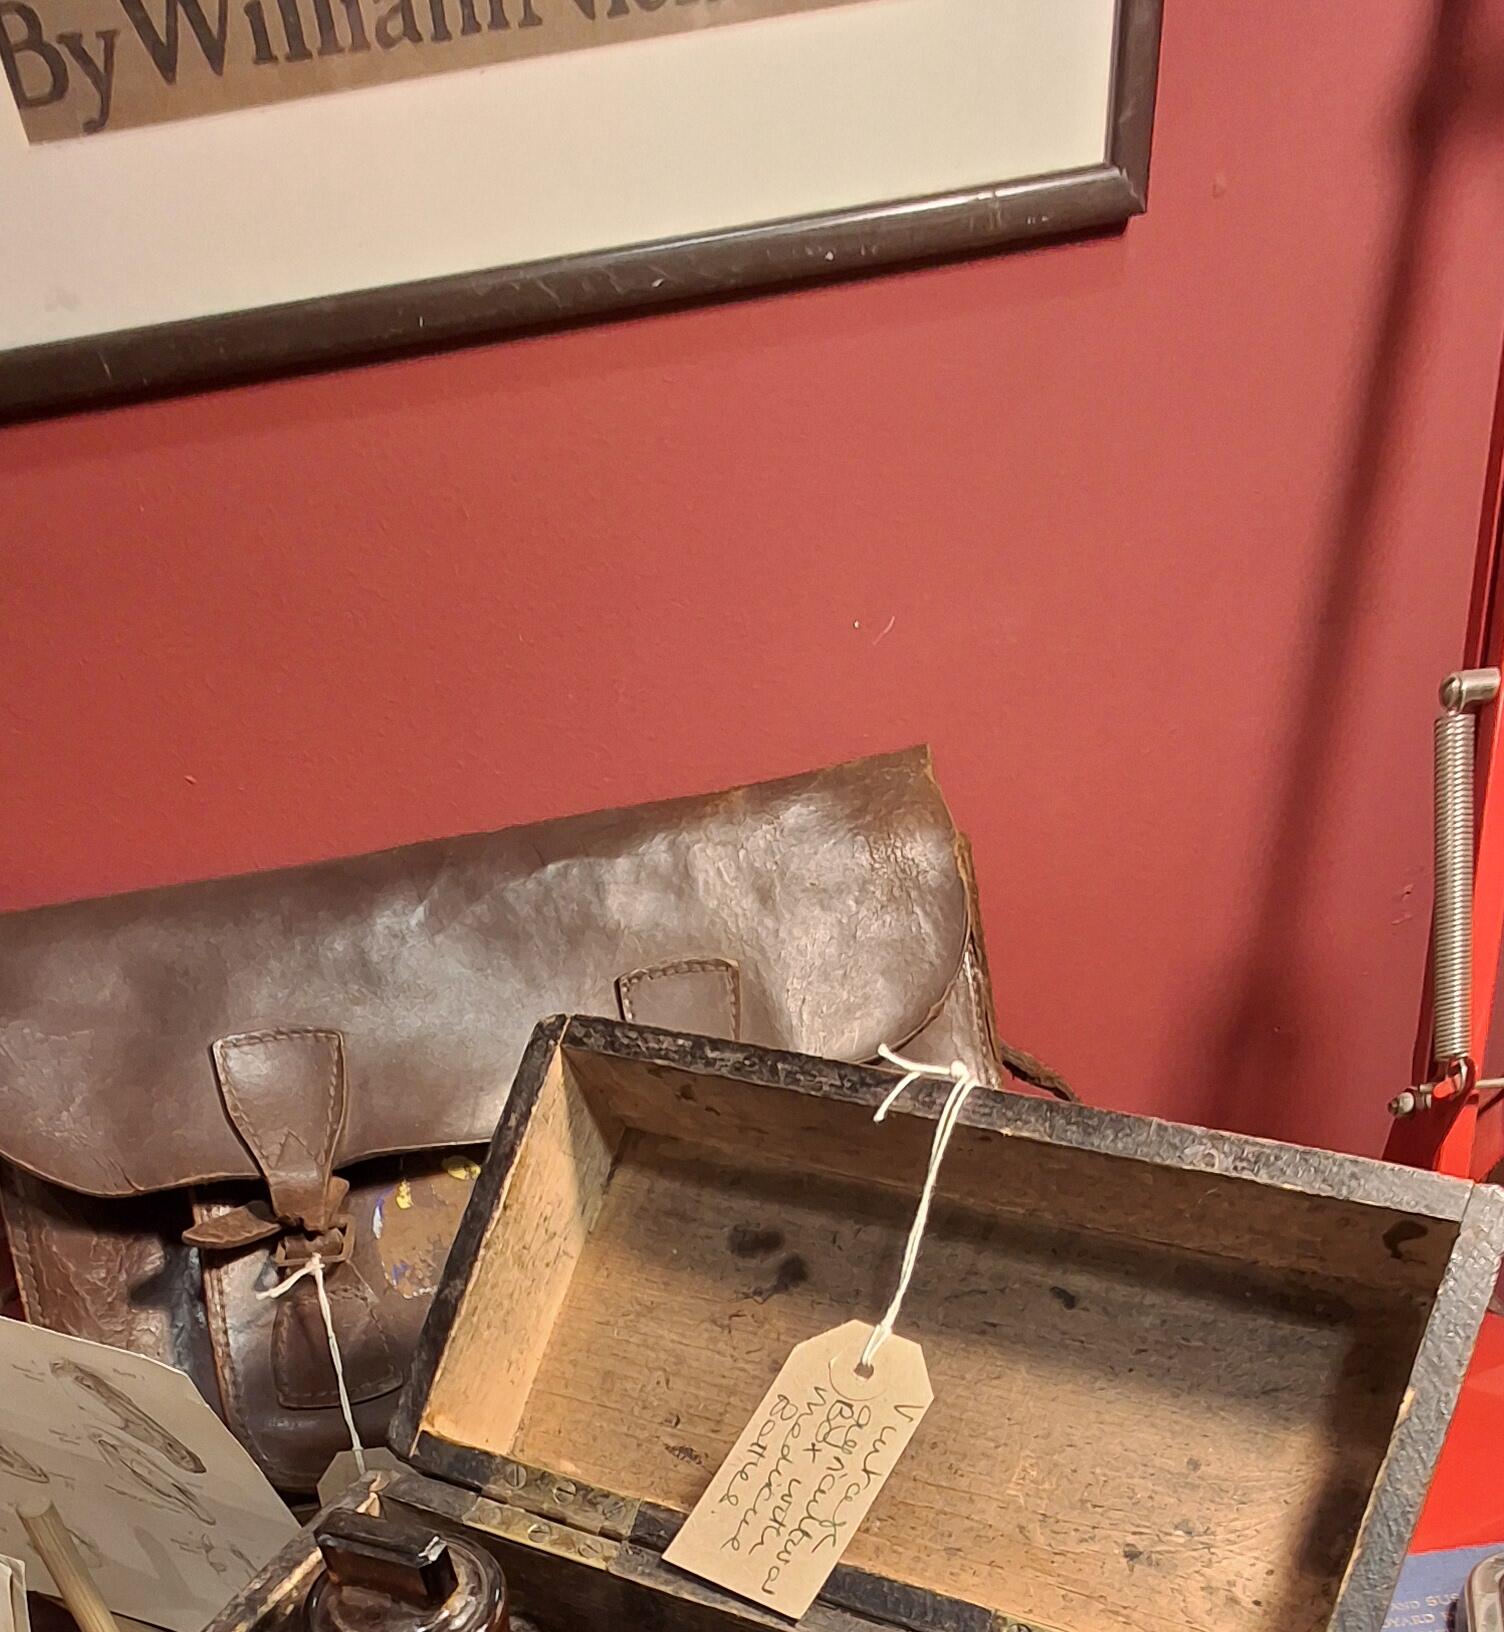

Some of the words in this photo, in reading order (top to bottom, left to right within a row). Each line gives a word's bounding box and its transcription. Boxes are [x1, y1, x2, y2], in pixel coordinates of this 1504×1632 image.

[0, 0, 119, 133] By
[802, 1400, 854, 1463] Box
[749, 1478, 801, 1555] with
